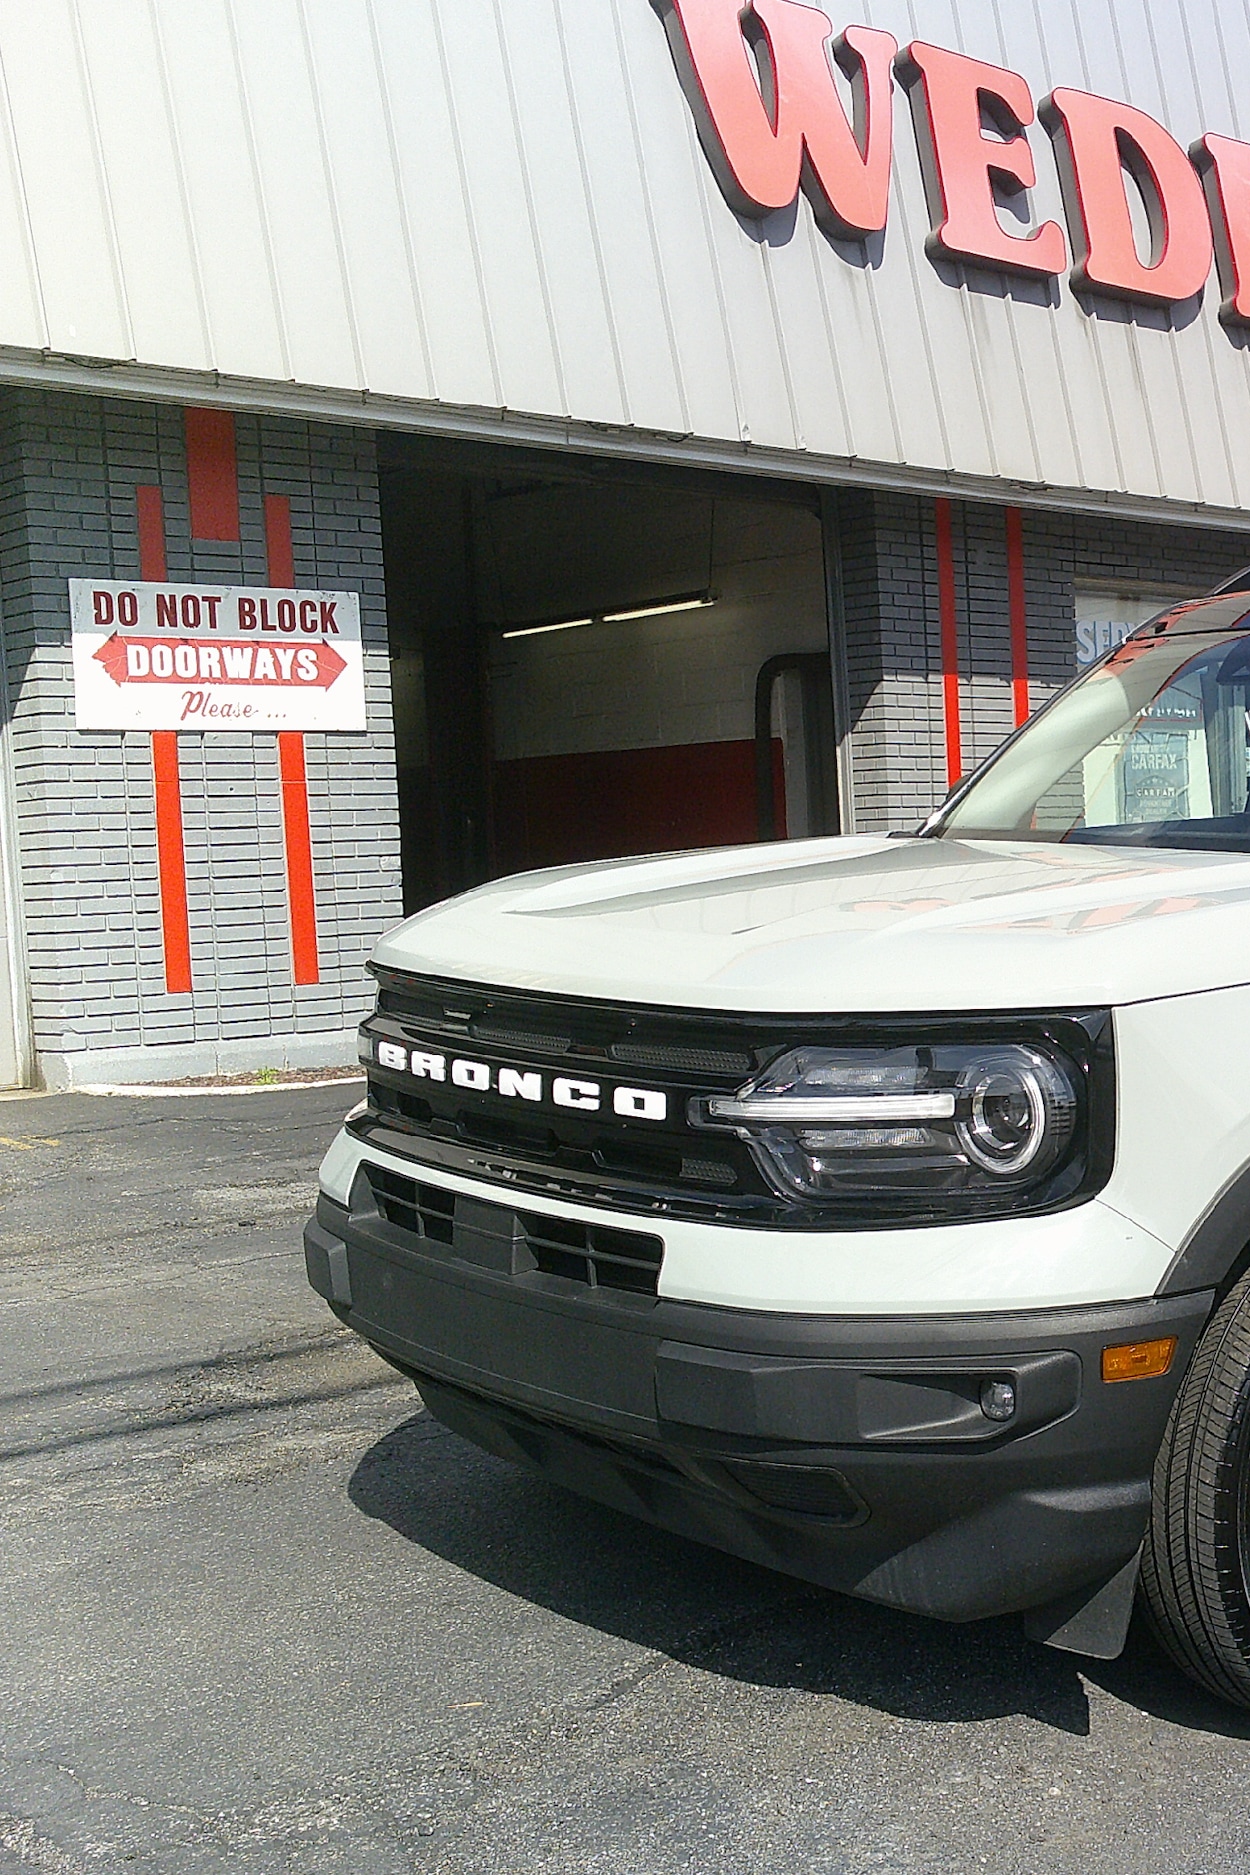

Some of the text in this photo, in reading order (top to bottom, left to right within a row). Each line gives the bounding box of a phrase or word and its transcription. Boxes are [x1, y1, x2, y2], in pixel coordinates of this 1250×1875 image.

[93, 591, 339, 634] DO NOT BLOCK
[126, 644, 319, 681] DOORWAYS
[180, 690, 260, 721] Please
[1131, 753, 1178, 770] CARFAX
[378, 1041, 667, 1120] BRONCO
